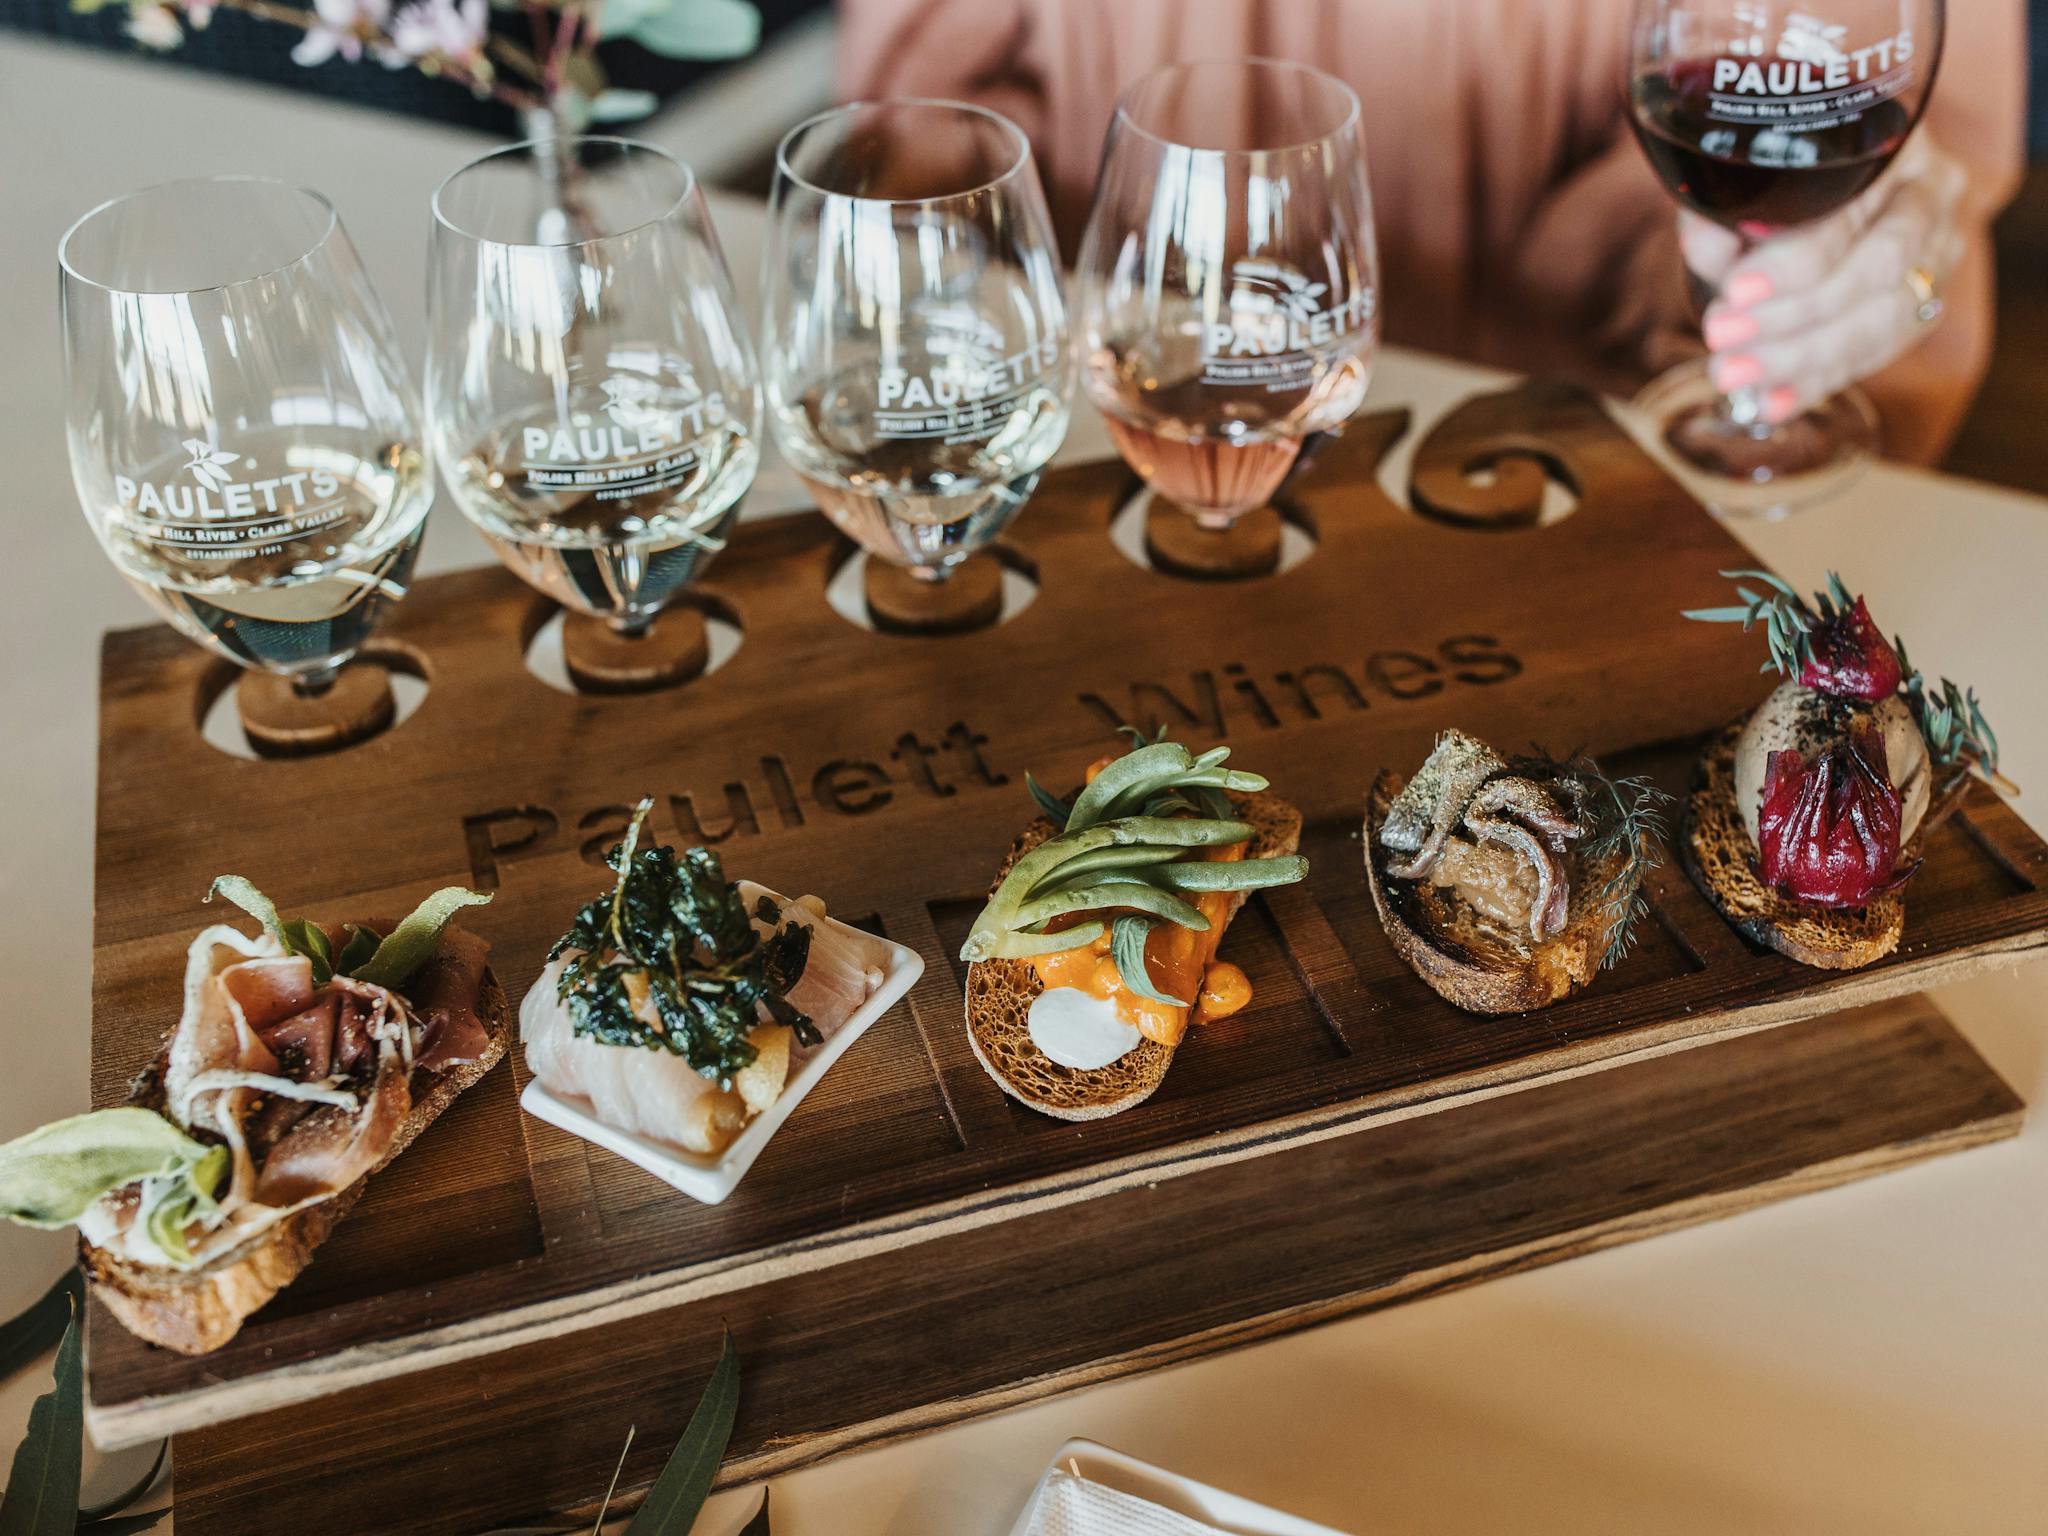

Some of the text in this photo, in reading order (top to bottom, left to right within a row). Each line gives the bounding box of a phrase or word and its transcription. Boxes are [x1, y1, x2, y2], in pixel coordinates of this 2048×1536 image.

[1713, 31, 1914, 95] PAULETTS
[115, 468, 339, 518] PAULETTS
[462, 633, 1523, 890] Paulett Wines
